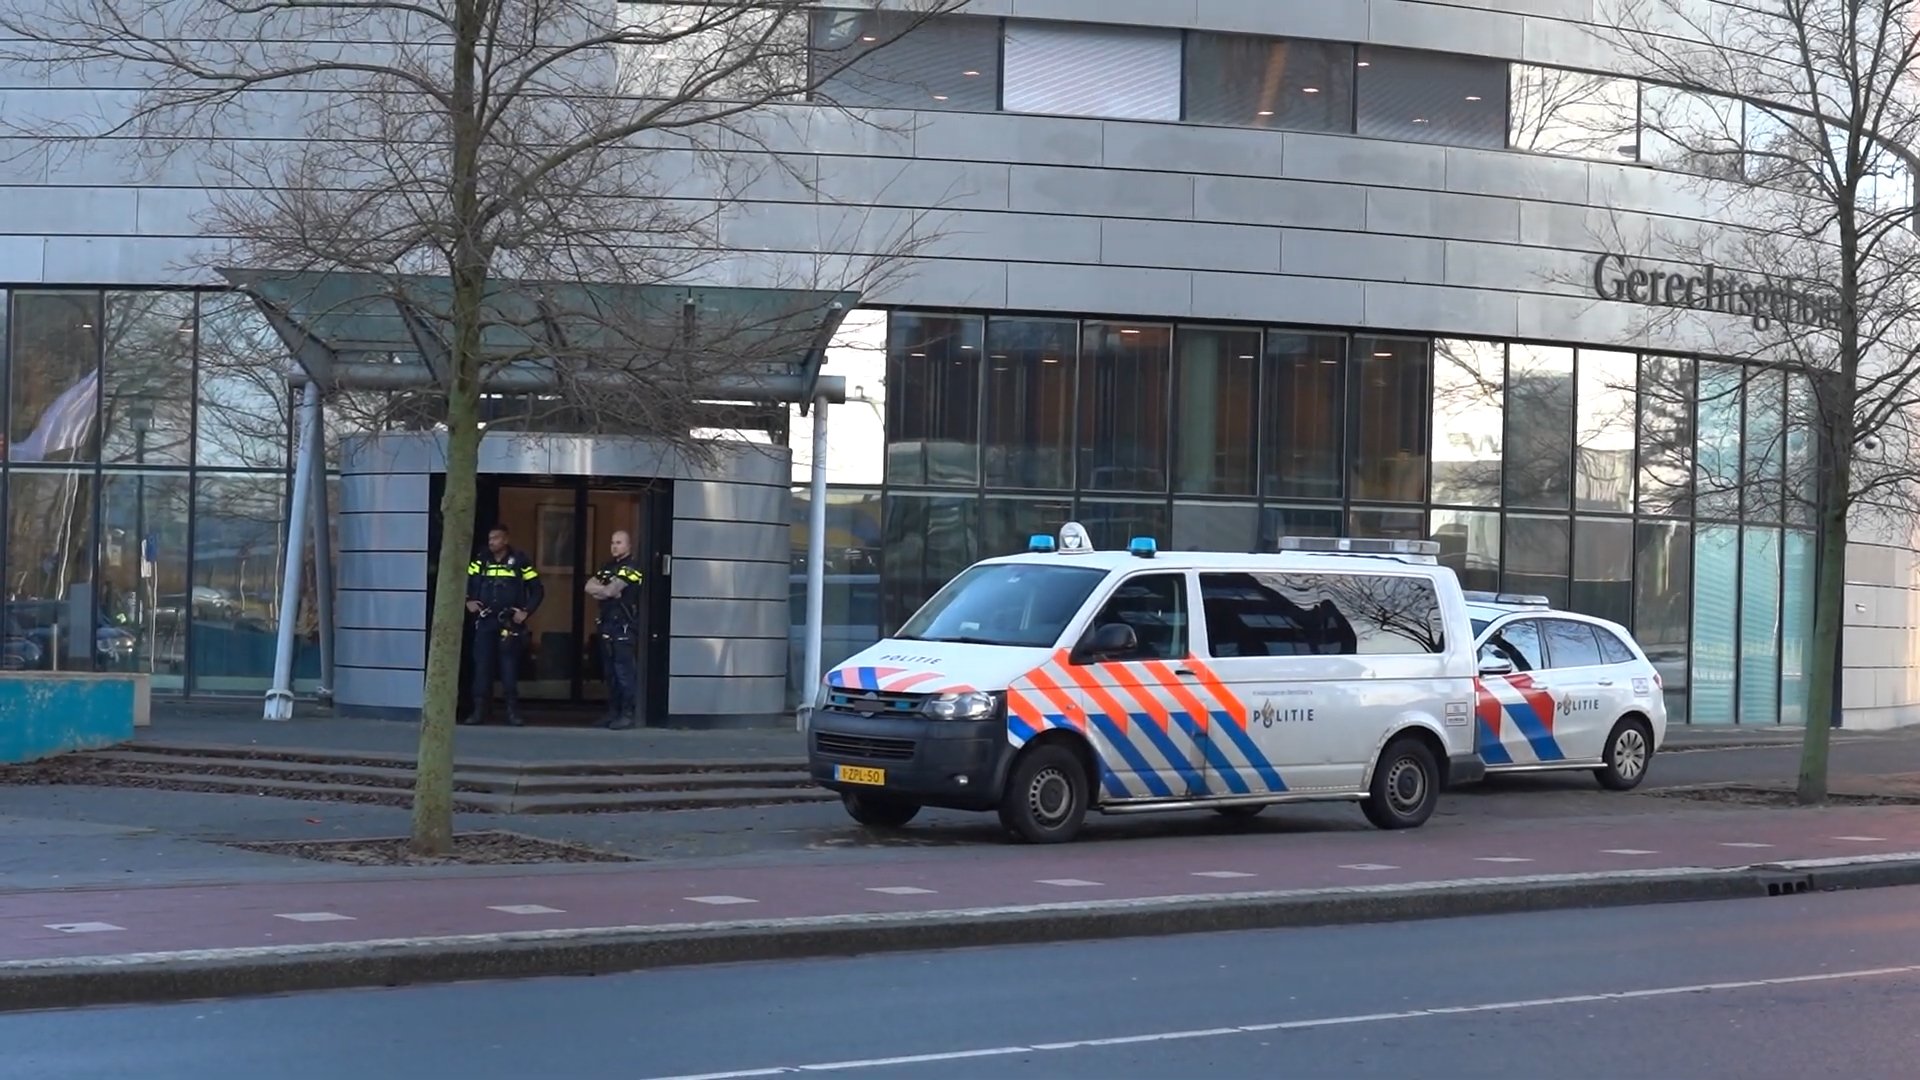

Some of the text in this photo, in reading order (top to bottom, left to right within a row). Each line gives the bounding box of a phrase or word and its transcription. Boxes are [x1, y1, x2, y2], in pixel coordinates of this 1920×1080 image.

[880, 654, 942, 665] POLITIE
[1556, 699, 1600, 716] POLITIE
[1252, 708, 1315, 729] POLITIE
